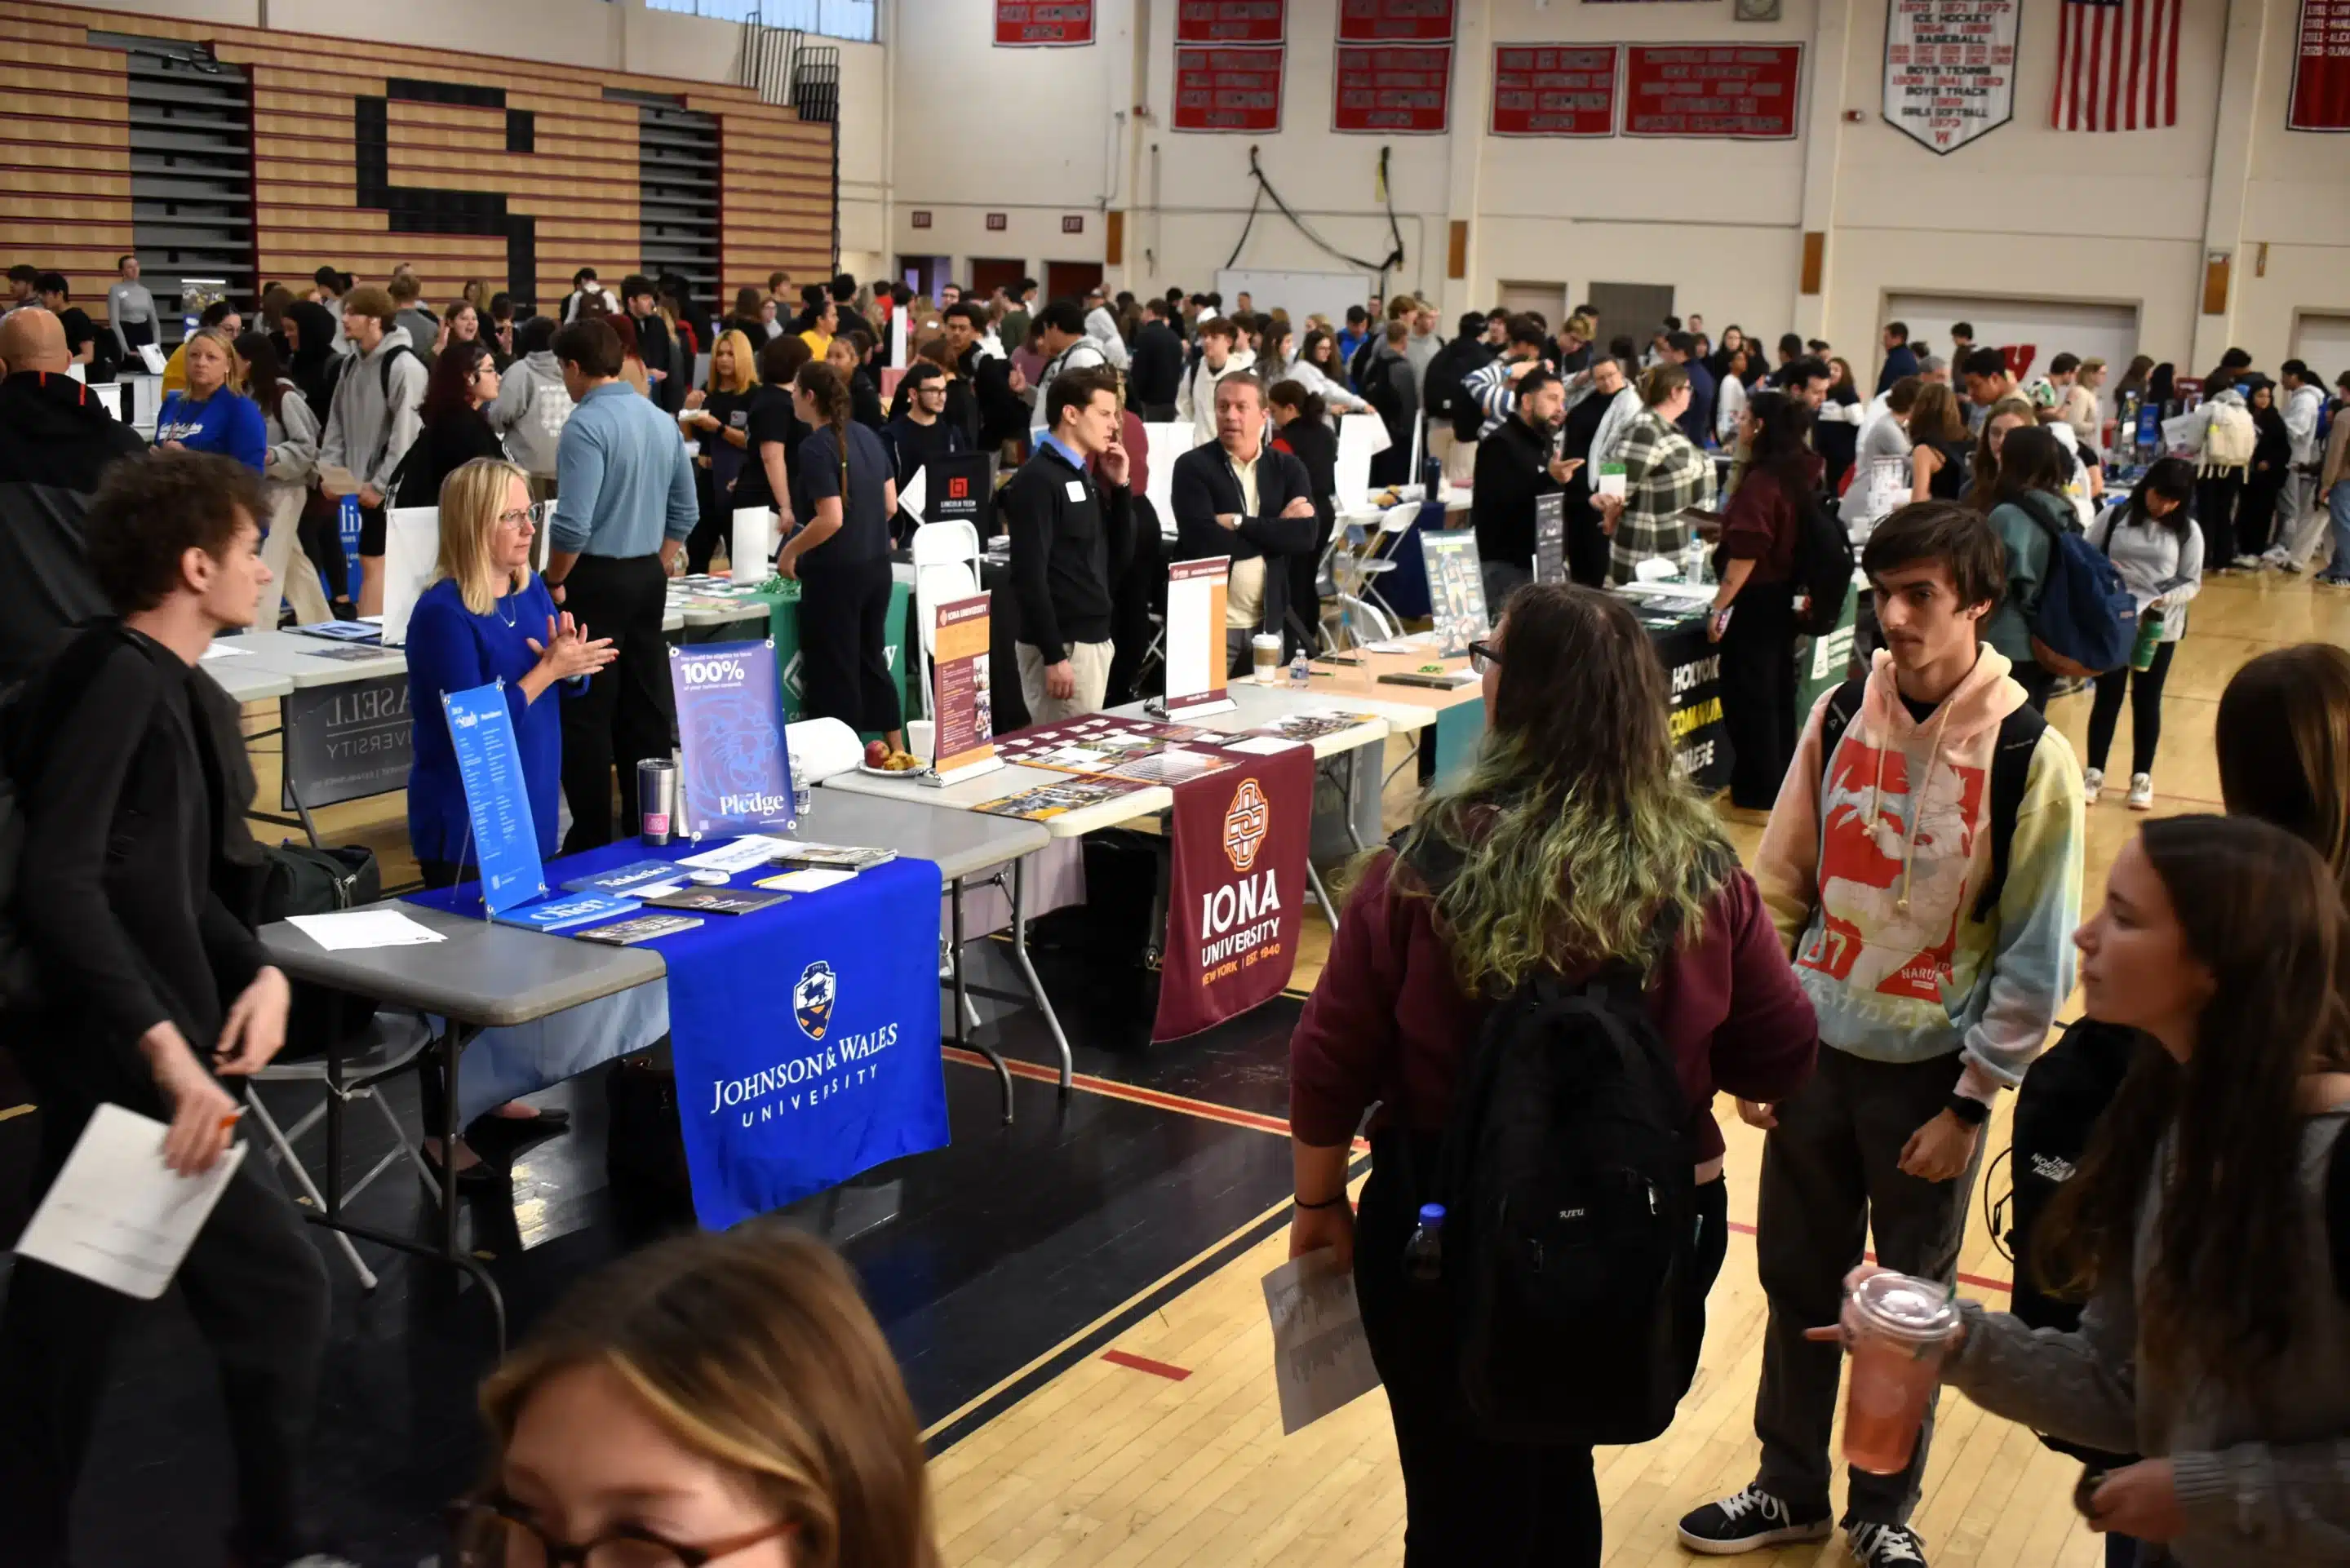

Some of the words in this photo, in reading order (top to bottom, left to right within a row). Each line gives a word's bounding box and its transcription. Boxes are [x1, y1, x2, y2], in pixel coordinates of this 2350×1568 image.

[681, 660, 744, 684] 100%
[1672, 653, 1721, 693] HOLYOK
[720, 791, 784, 816] Pledge
[1202, 868, 1280, 940] IONA
[1202, 917, 1280, 967] UNIVERSITY
[1217, 959, 1238, 977] YORK
[710, 1053, 823, 1115] JOHNSON
[826, 1047, 836, 1068] &
[839, 1023, 898, 1063] WALES
[742, 1064, 878, 1127] UNIVERSITY
